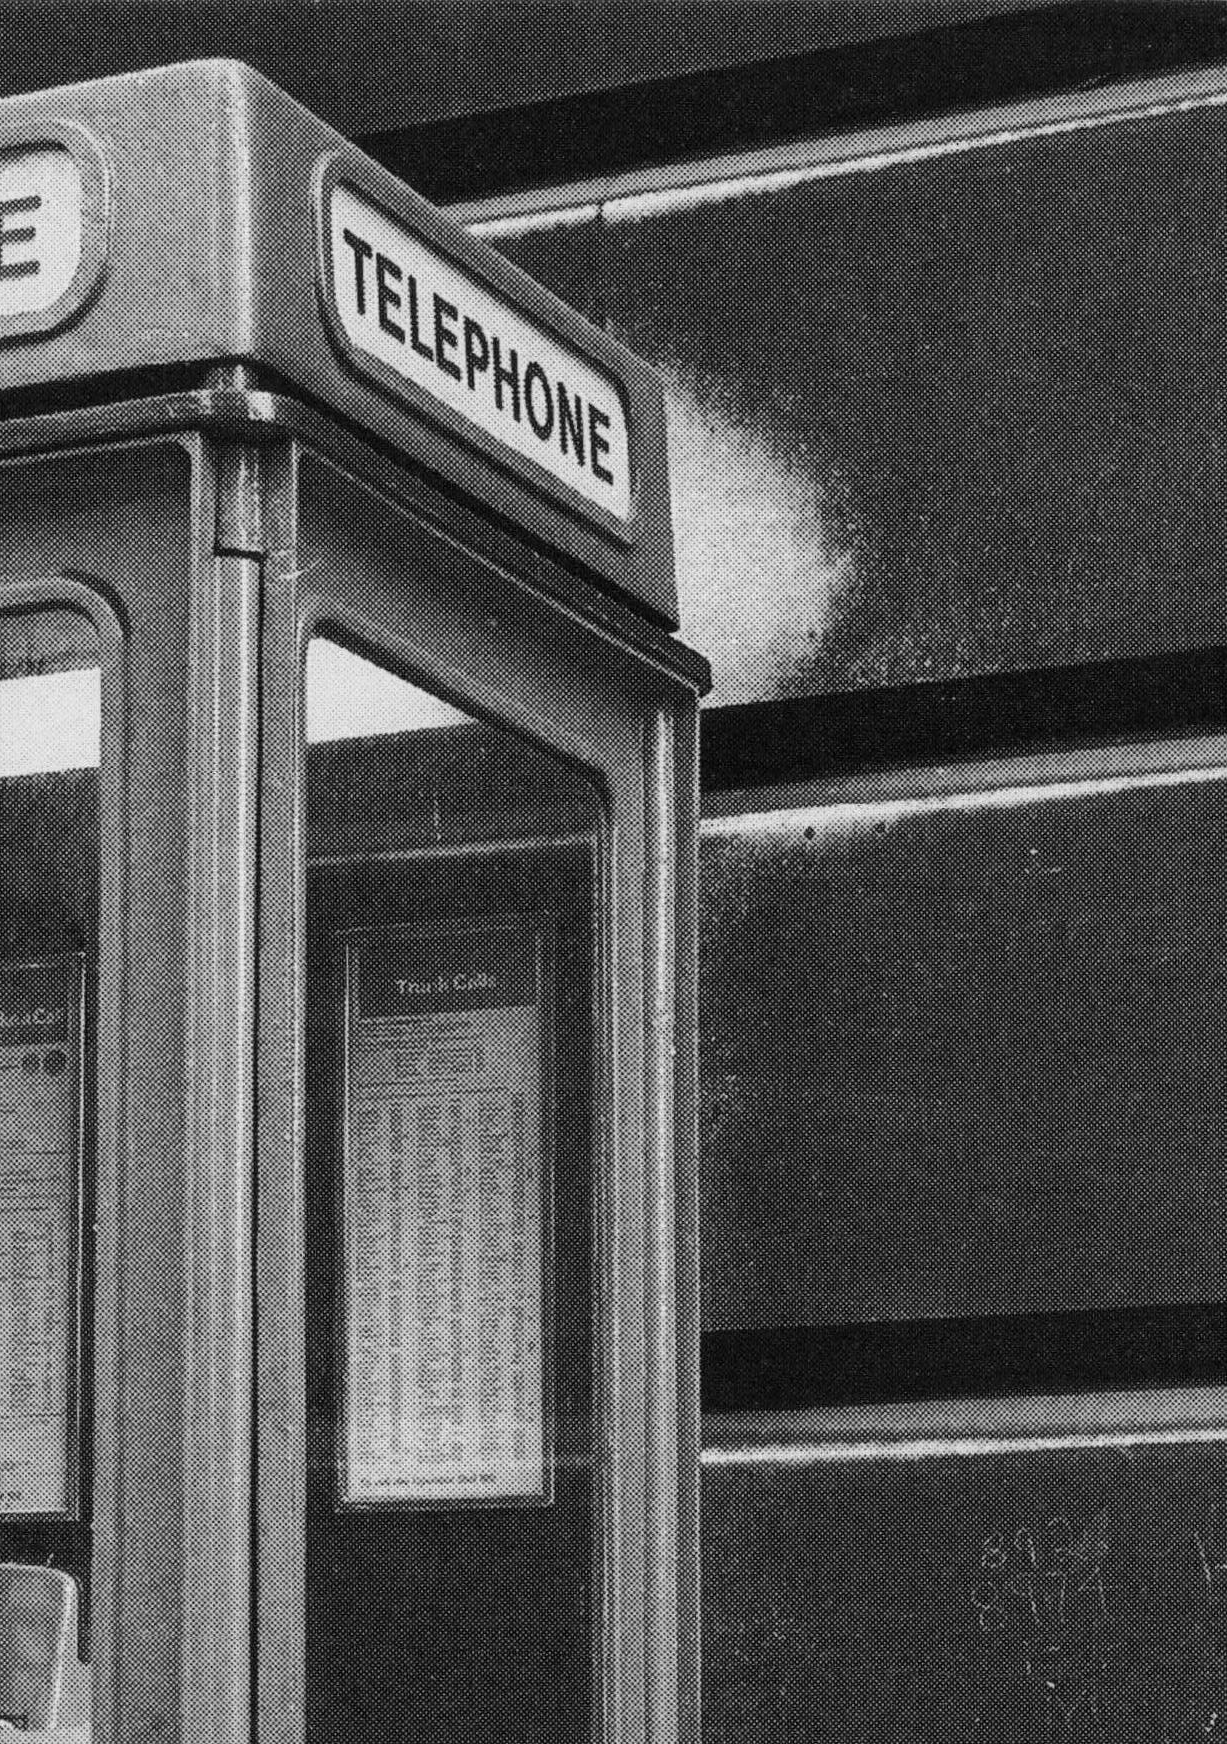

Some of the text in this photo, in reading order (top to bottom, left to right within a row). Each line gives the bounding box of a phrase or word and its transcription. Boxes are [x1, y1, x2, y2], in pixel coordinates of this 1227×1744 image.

[342, 228, 615, 486] TELEPHONE
[394, 971, 497, 995] Trunk Calls
